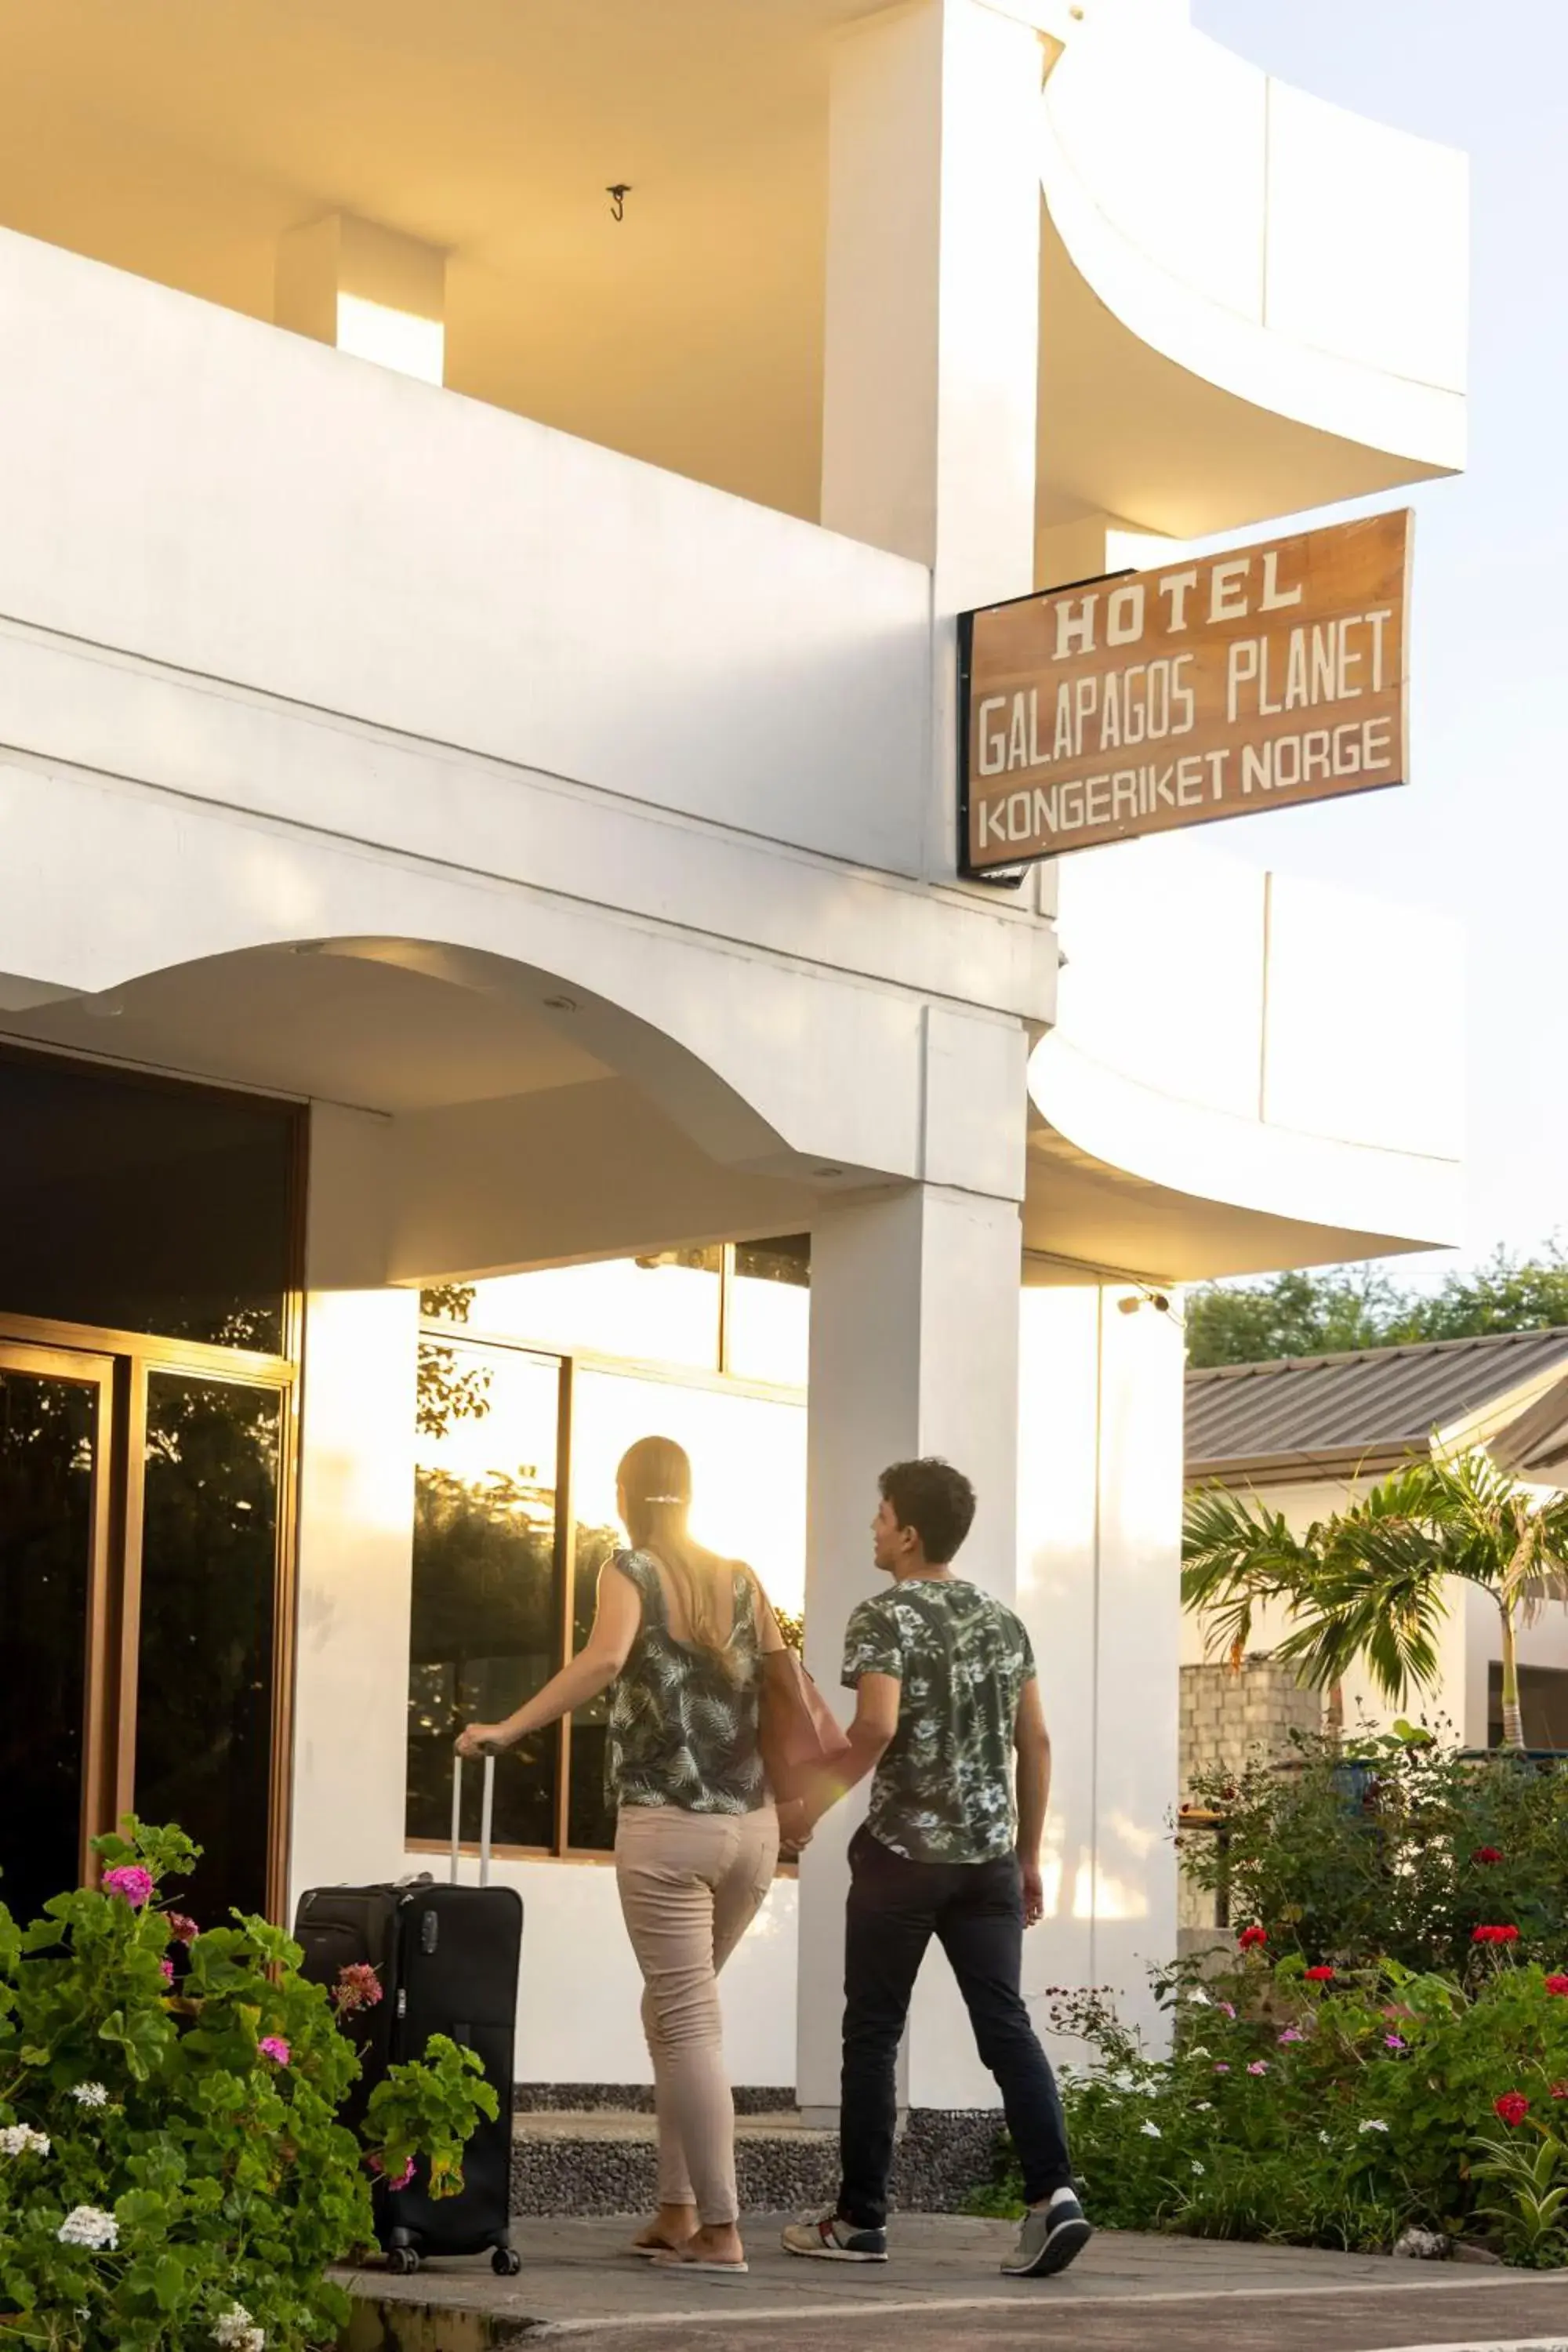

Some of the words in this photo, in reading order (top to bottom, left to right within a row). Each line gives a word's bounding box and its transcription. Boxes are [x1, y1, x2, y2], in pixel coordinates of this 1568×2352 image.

[1051, 551, 1301, 661] HOTEL
[979, 654, 1194, 776] GALAPAGOS
[1228, 609, 1392, 723] PLANET
[979, 750, 1230, 848] KONGERIKET
[1242, 717, 1392, 794] NORGE
